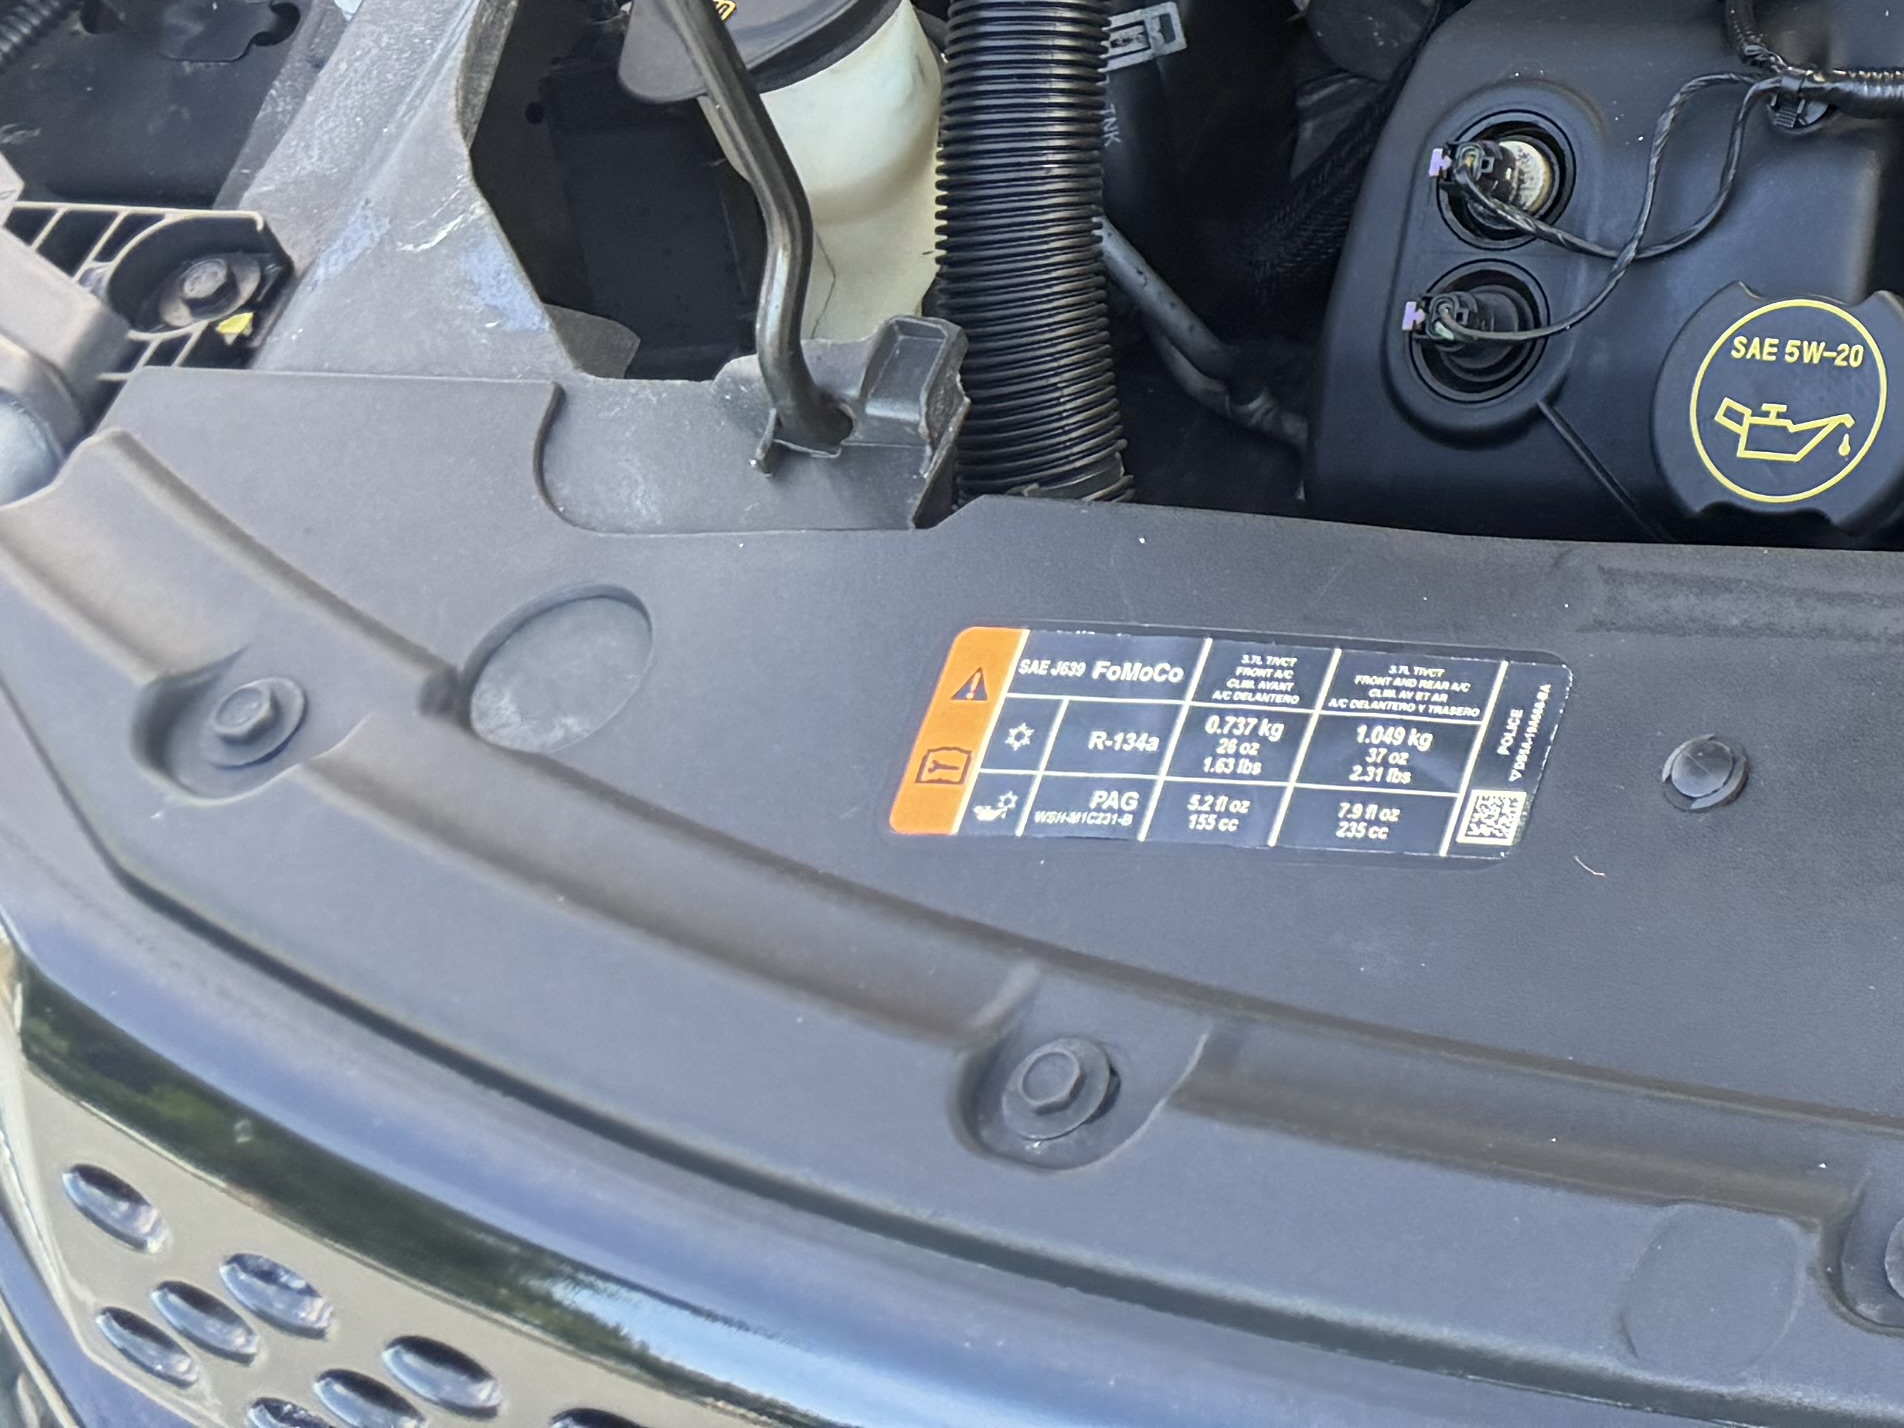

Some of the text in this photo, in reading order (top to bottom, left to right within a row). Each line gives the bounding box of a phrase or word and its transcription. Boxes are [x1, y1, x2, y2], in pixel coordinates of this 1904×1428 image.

[1730, 336, 1865, 369] SAE 5W-20
[1241, 654, 1263, 665] 3.7L
[1018, 658, 1185, 684] SAE J639 FoMoCo
[1235, 666, 1295, 679] FRONT A/C
[1257, 680, 1295, 692] AVANT
[1354, 675, 1471, 693] FRONT AND REAR A/C
[1211, 690, 1300, 704] A/C DELANTERO
[1398, 689, 1414, 700] AV
[1415, 691, 1431, 702] ET
[1431, 692, 1449, 704] AR
[1328, 697, 1349, 709] A/C
[1349, 698, 1416, 713] DELANTERO
[1428, 704, 1481, 718] TRASERO
[1204, 714, 1285, 743] 0.737 kg
[1355, 724, 1434, 752] 1.049 kg
[1496, 708, 1524, 757] POLICE
[1087, 730, 1161, 753] R-134a
[1238, 741, 1261, 756] oz
[1203, 756, 1263, 776] 1.63 lbs
[1365, 747, 1410, 766] 37 oz
[1349, 765, 1412, 785] 2.31 lbs
[1088, 790, 1140, 811] PAG
[1187, 794, 1251, 814] 5.2 fl oz
[1188, 813, 1239, 832] 155 cc
[1337, 802, 1401, 823] 7.9 fl oz
[1335, 821, 1390, 840] 235 cc
